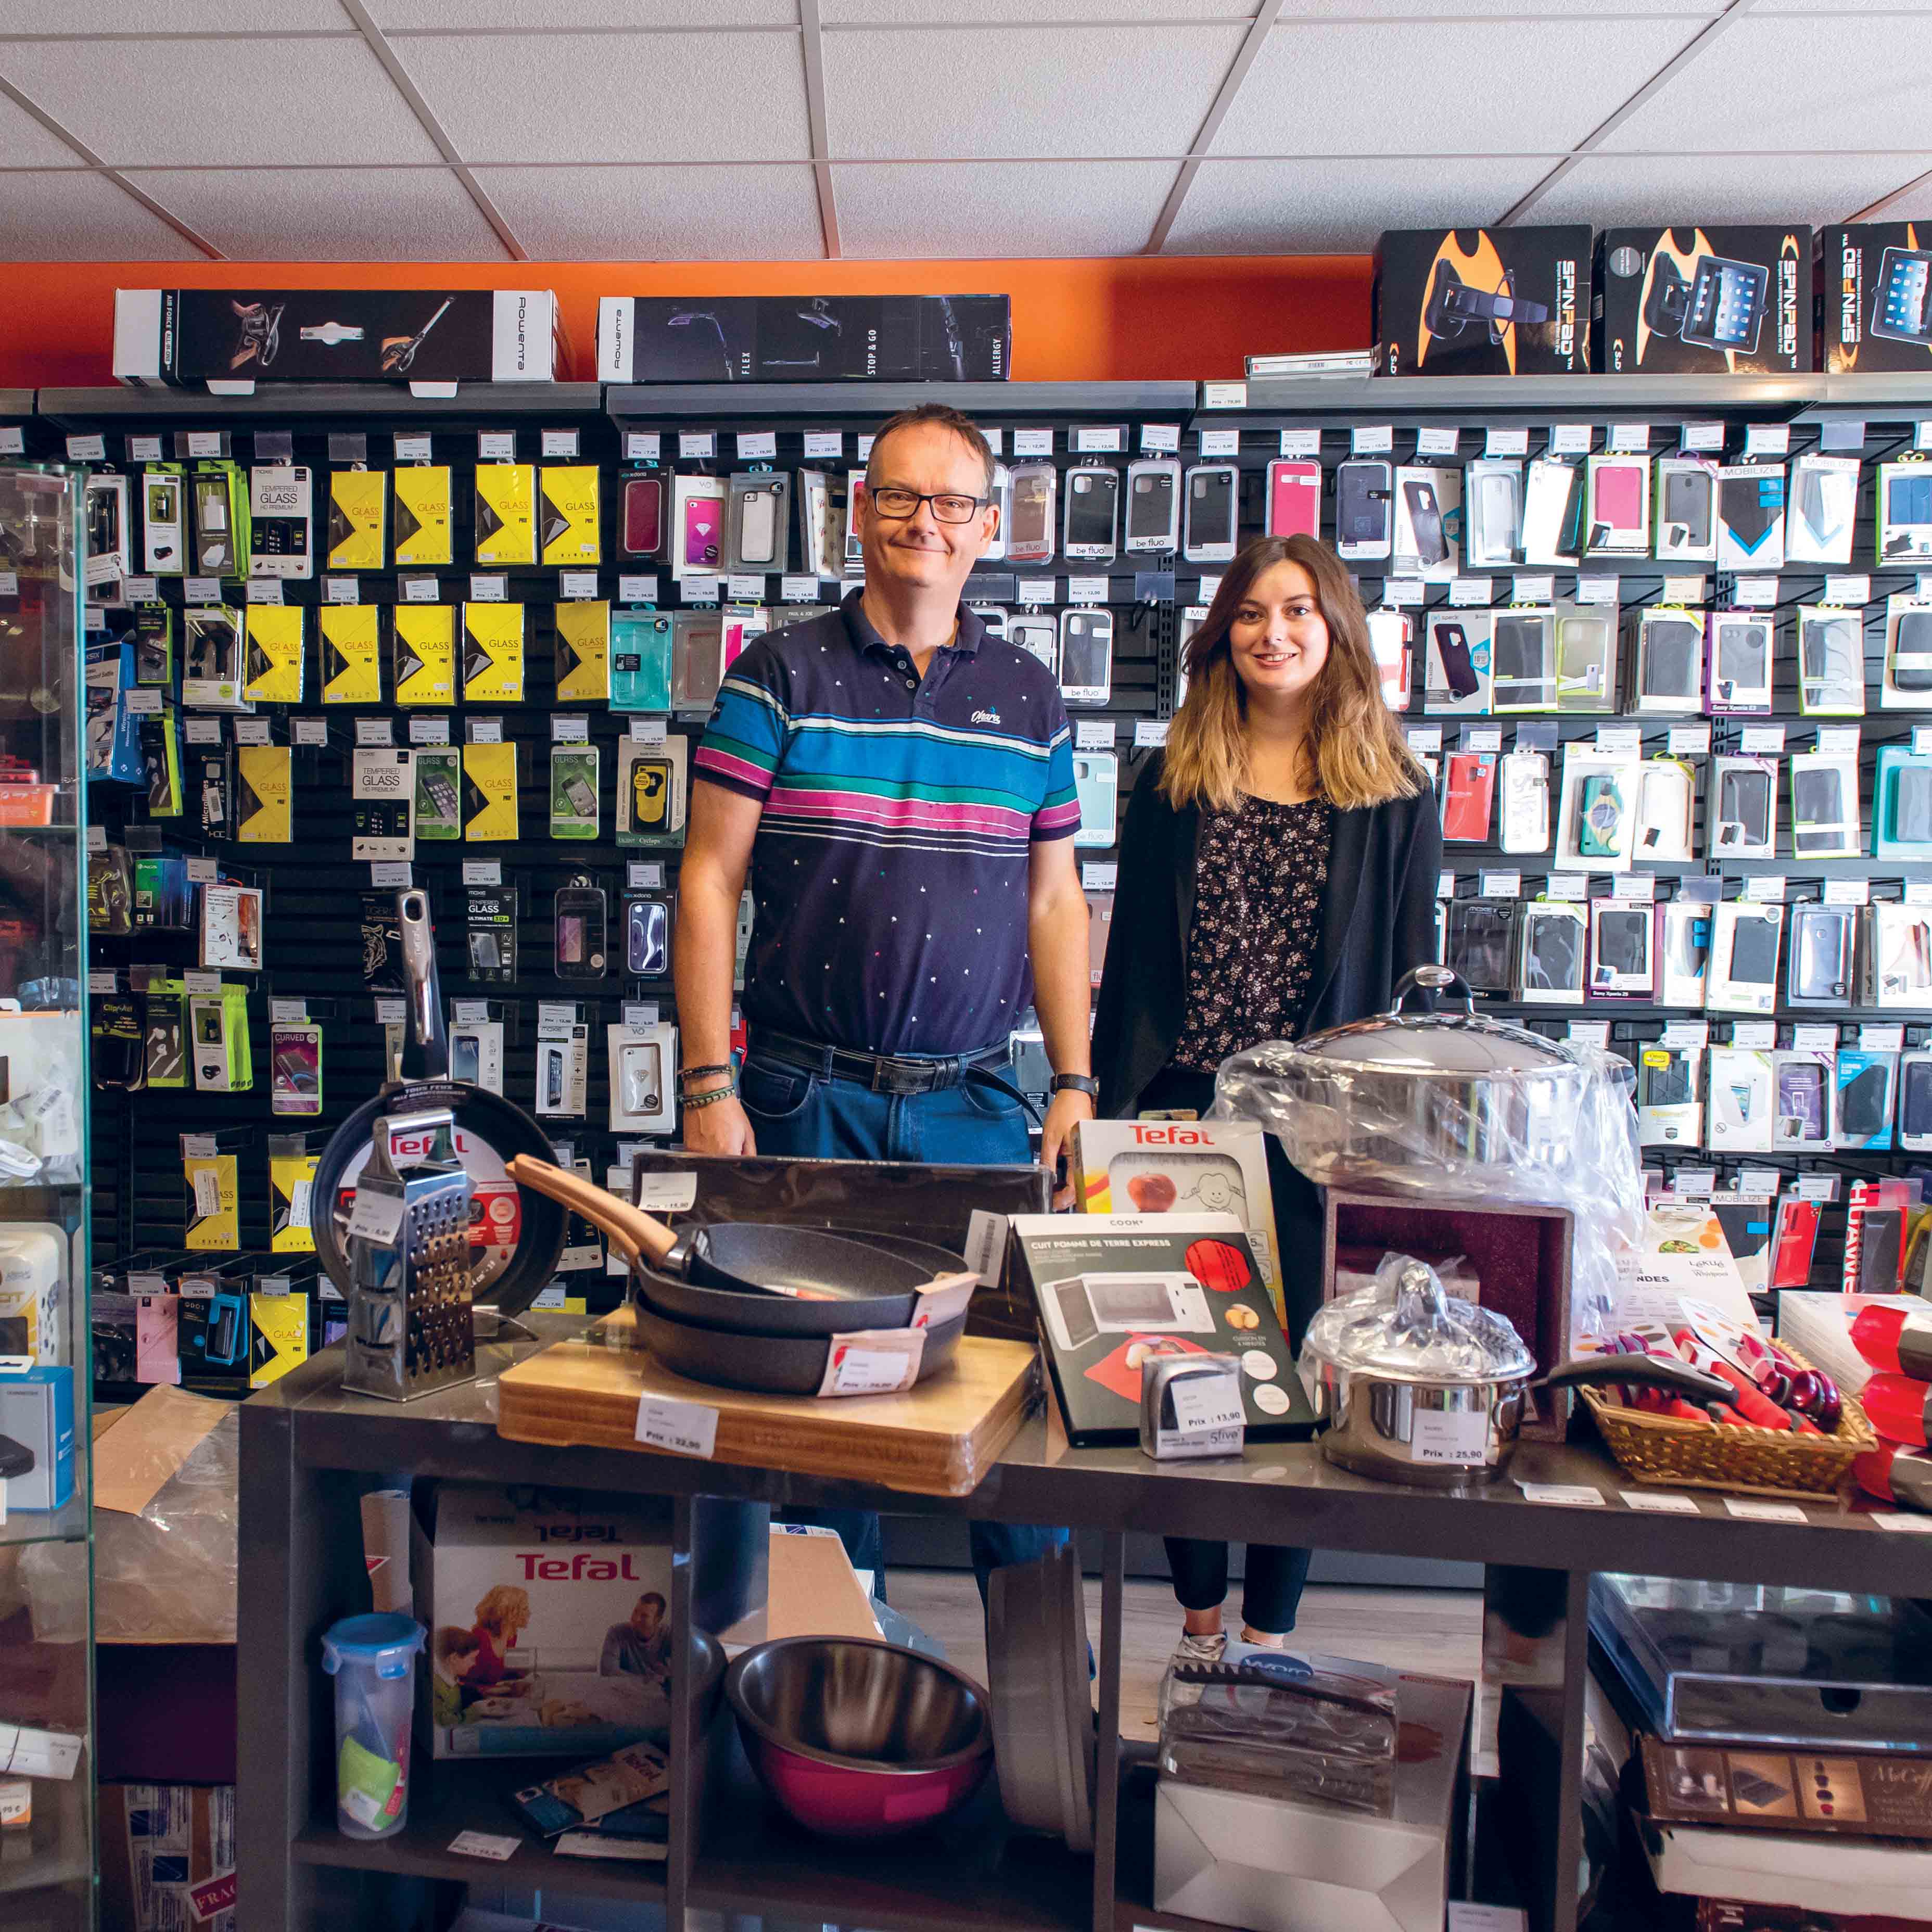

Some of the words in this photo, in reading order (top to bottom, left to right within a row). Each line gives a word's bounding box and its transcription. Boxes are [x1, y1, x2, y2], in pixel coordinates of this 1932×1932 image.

[867, 329, 876, 343] GO
[993, 339, 1001, 374] ALLERGY
[742, 352, 751, 374] FLEX
[867, 353, 876, 374] STOP
[1807, 459, 1853, 468] MOBILIZE
[1724, 466, 1777, 476] MOBILIZE
[261, 493, 297, 503] GLASS
[417, 503, 446, 512] GLASS
[500, 501, 529, 510] GLASS
[566, 502, 595, 511] GLASS
[1136, 539, 1147, 548] be
[1148, 538, 1165, 546] fluo
[1076, 546, 1087, 555] be
[1087, 546, 1105, 554] fluo
[345, 642, 374, 650] GLASS
[420, 642, 449, 651] GLASS
[489, 640, 518, 649] GLASS
[578, 638, 604, 646] GLASS
[1071, 688, 1081, 697] be
[1083, 688, 1099, 697] fluo
[363, 776, 400, 786] GLASS
[485, 780, 512, 788] GLASS
[468, 905, 499, 913] GLASS
[1129, 1125, 1215, 1146] Tefal
[390, 1135, 469, 1155] Tefl
[218, 1190, 234, 1199] ASS
[1715, 1194, 1764, 1203] MOBILIZE
[1842, 1185, 1867, 1293] HUAWE
[1031, 1241, 1052, 1250] CUIT
[1053, 1240, 1088, 1249] POMME
[273, 1330, 302, 1339] GLA
[1217, 1412, 1240, 1421] 13,90
[1423, 1449, 1443, 1458] Prix
[1456, 1450, 1482, 1459] 25,90
[533, 1524, 624, 1543] Tefal
[515, 1554, 639, 1581] Tefal
